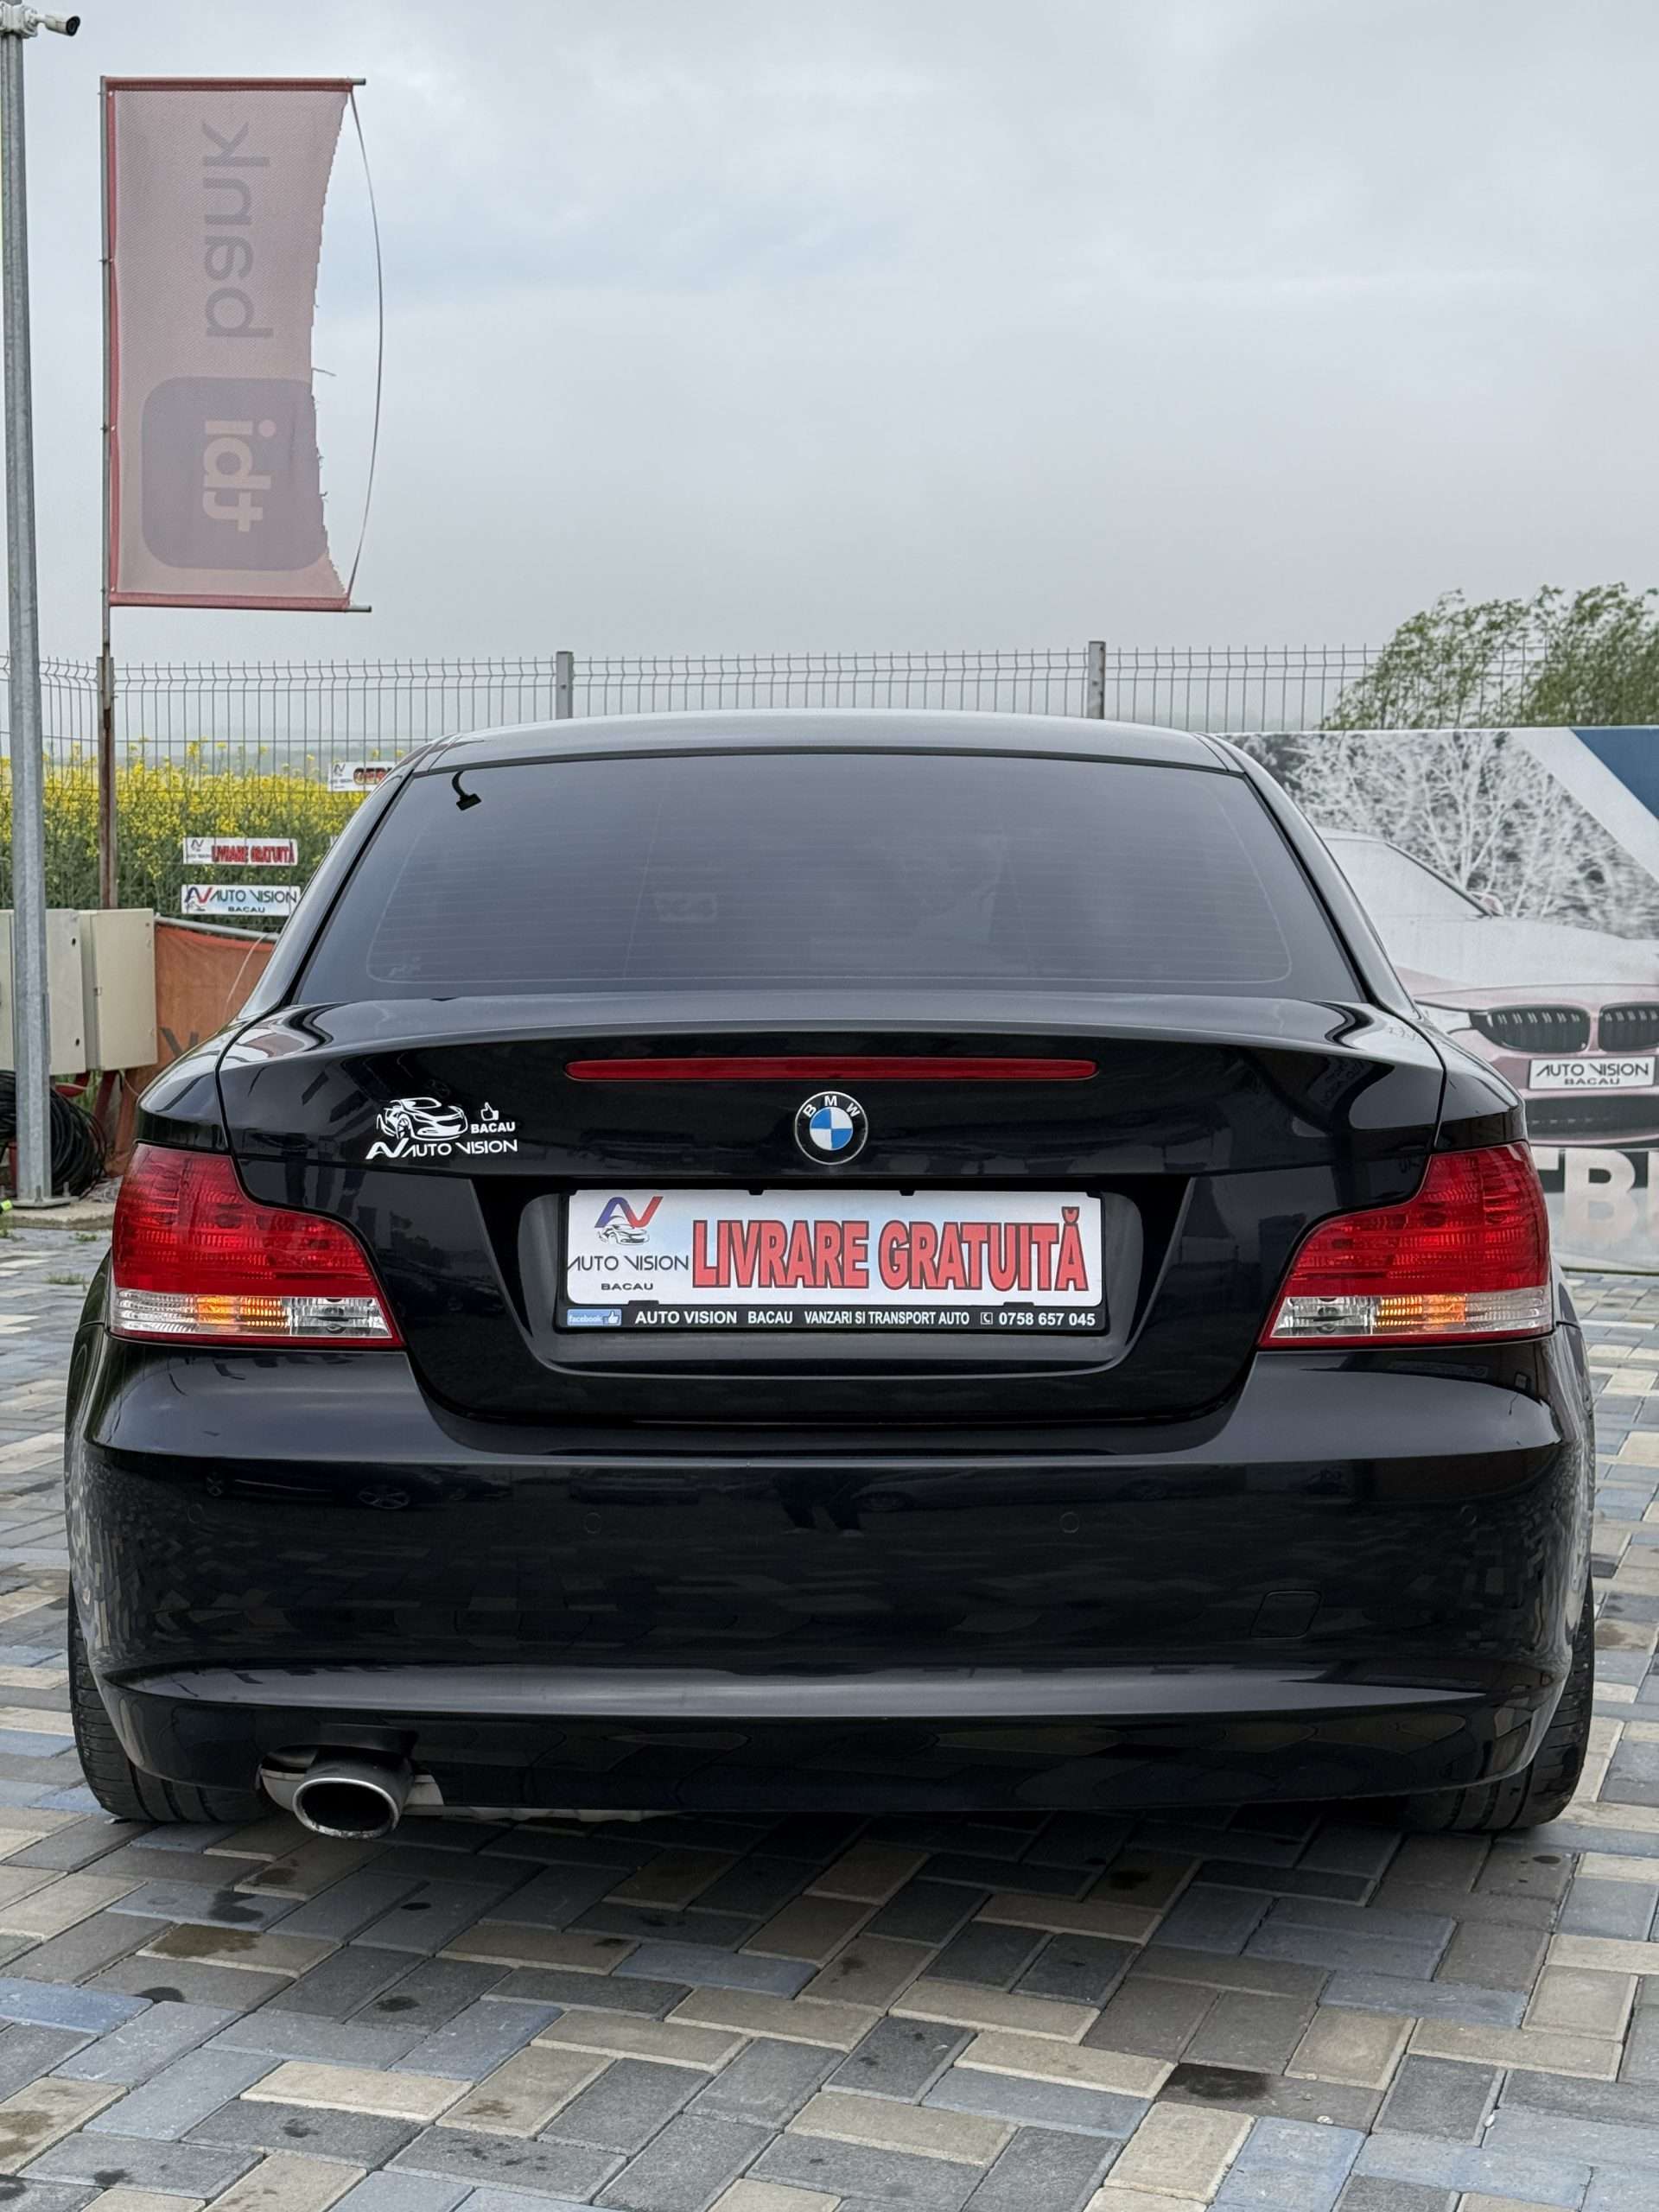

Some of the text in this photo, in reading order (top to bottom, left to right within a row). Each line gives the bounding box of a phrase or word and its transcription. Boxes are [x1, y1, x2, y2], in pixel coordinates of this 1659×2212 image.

[210, 889, 297, 903] AUTO VISION
[1536, 1063, 1649, 1077] AUTO VISION
[803, 1095, 861, 1118] BMW
[471, 1122, 516, 1134] BACAU
[402, 1140, 518, 1158] AUTO VISION
[692, 1206, 1089, 1292] LIVRARE GRATUITĂ
[567, 1255, 689, 1271] AUTO VISION
[635, 1311, 1096, 1326] AUTO VISION BACAU VANZARI SI TRANSPORT AUTO 0758 657 045
